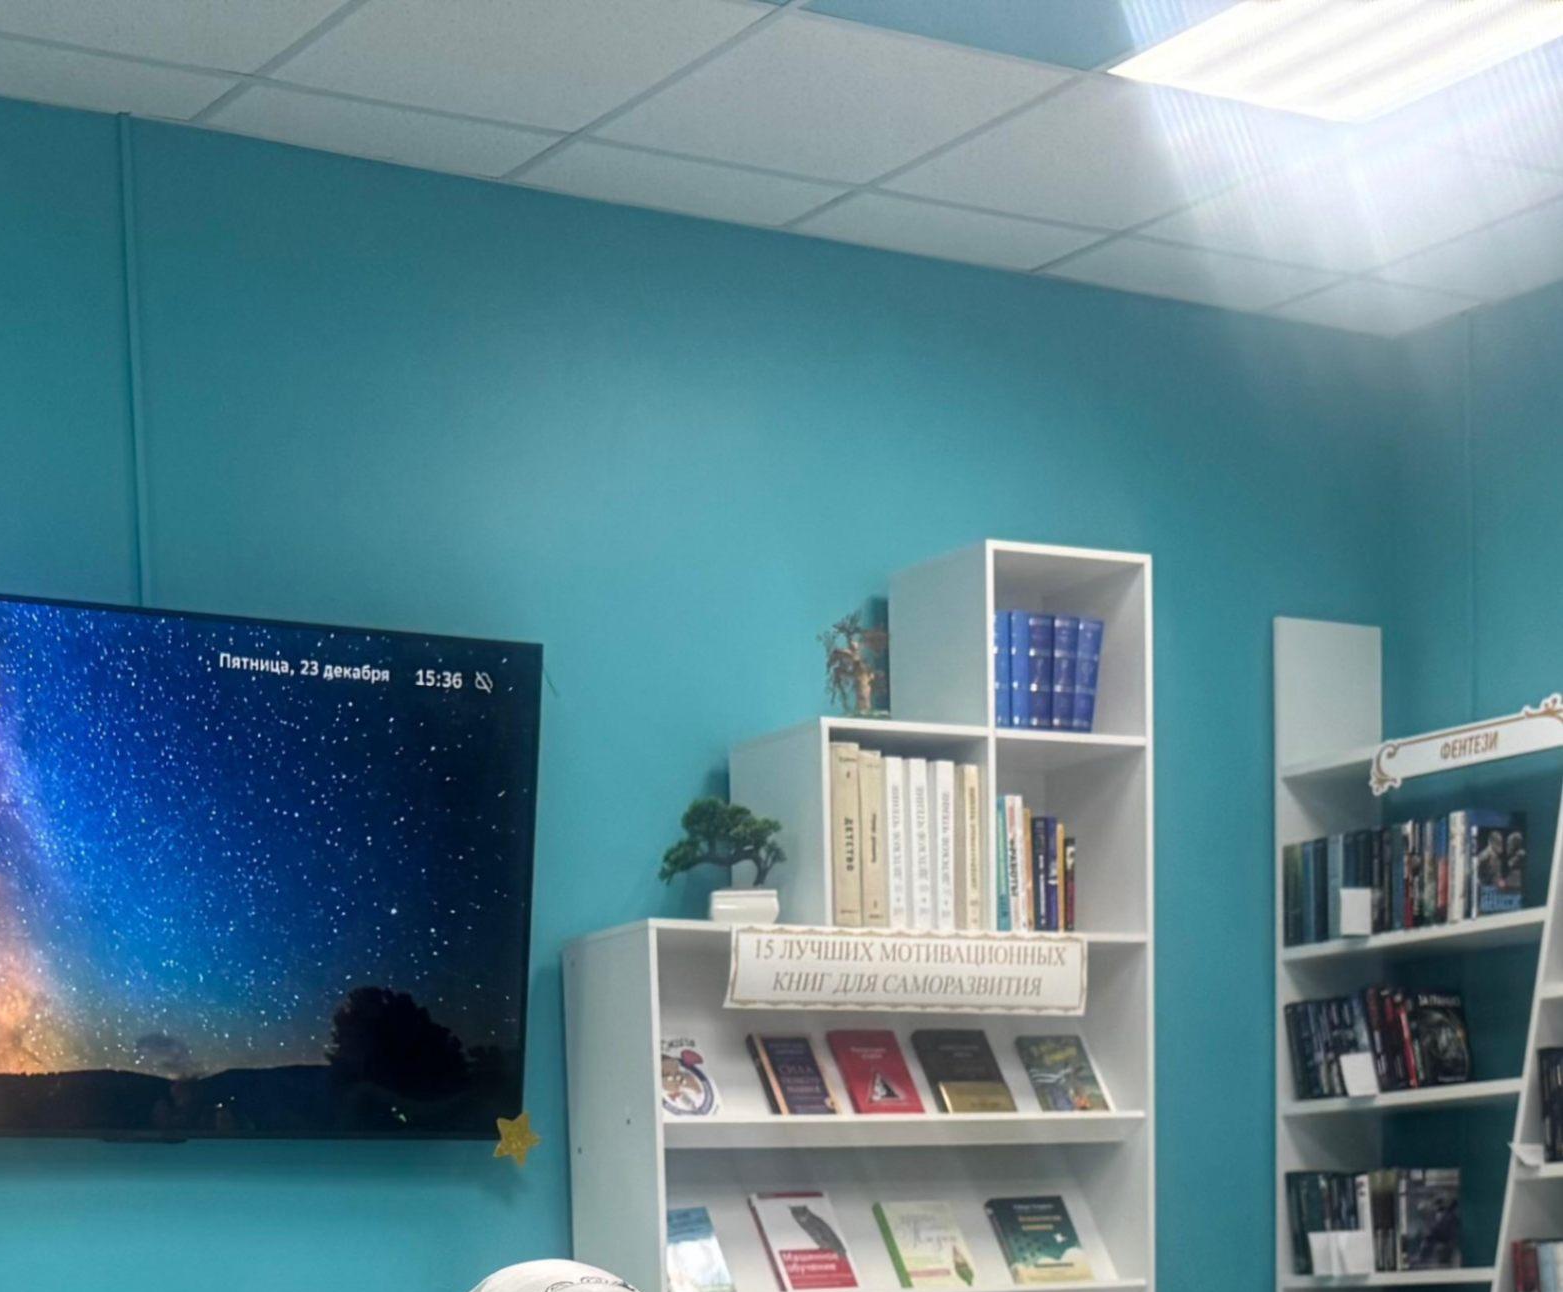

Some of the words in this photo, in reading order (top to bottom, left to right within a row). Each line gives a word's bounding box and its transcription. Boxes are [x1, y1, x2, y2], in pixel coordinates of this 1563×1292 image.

[219, 652, 295, 677] Пятница,
[300, 660, 319, 676] 23
[323, 662, 390, 684] декабря
[415, 669, 463, 689] 15:36
[1440, 731, 1499, 760] ФЕНТЕЗИ
[754, 939, 774, 960] 15
[778, 940, 874, 963] ЛУЧШИХ
[879, 943, 1066, 967] МОТИВАЦИОННЫХ
[772, 971, 832, 992] КНИГ
[833, 973, 879, 994] ДЛЯ
[882, 974, 1043, 998] САМОРАЗВИТИЯ
